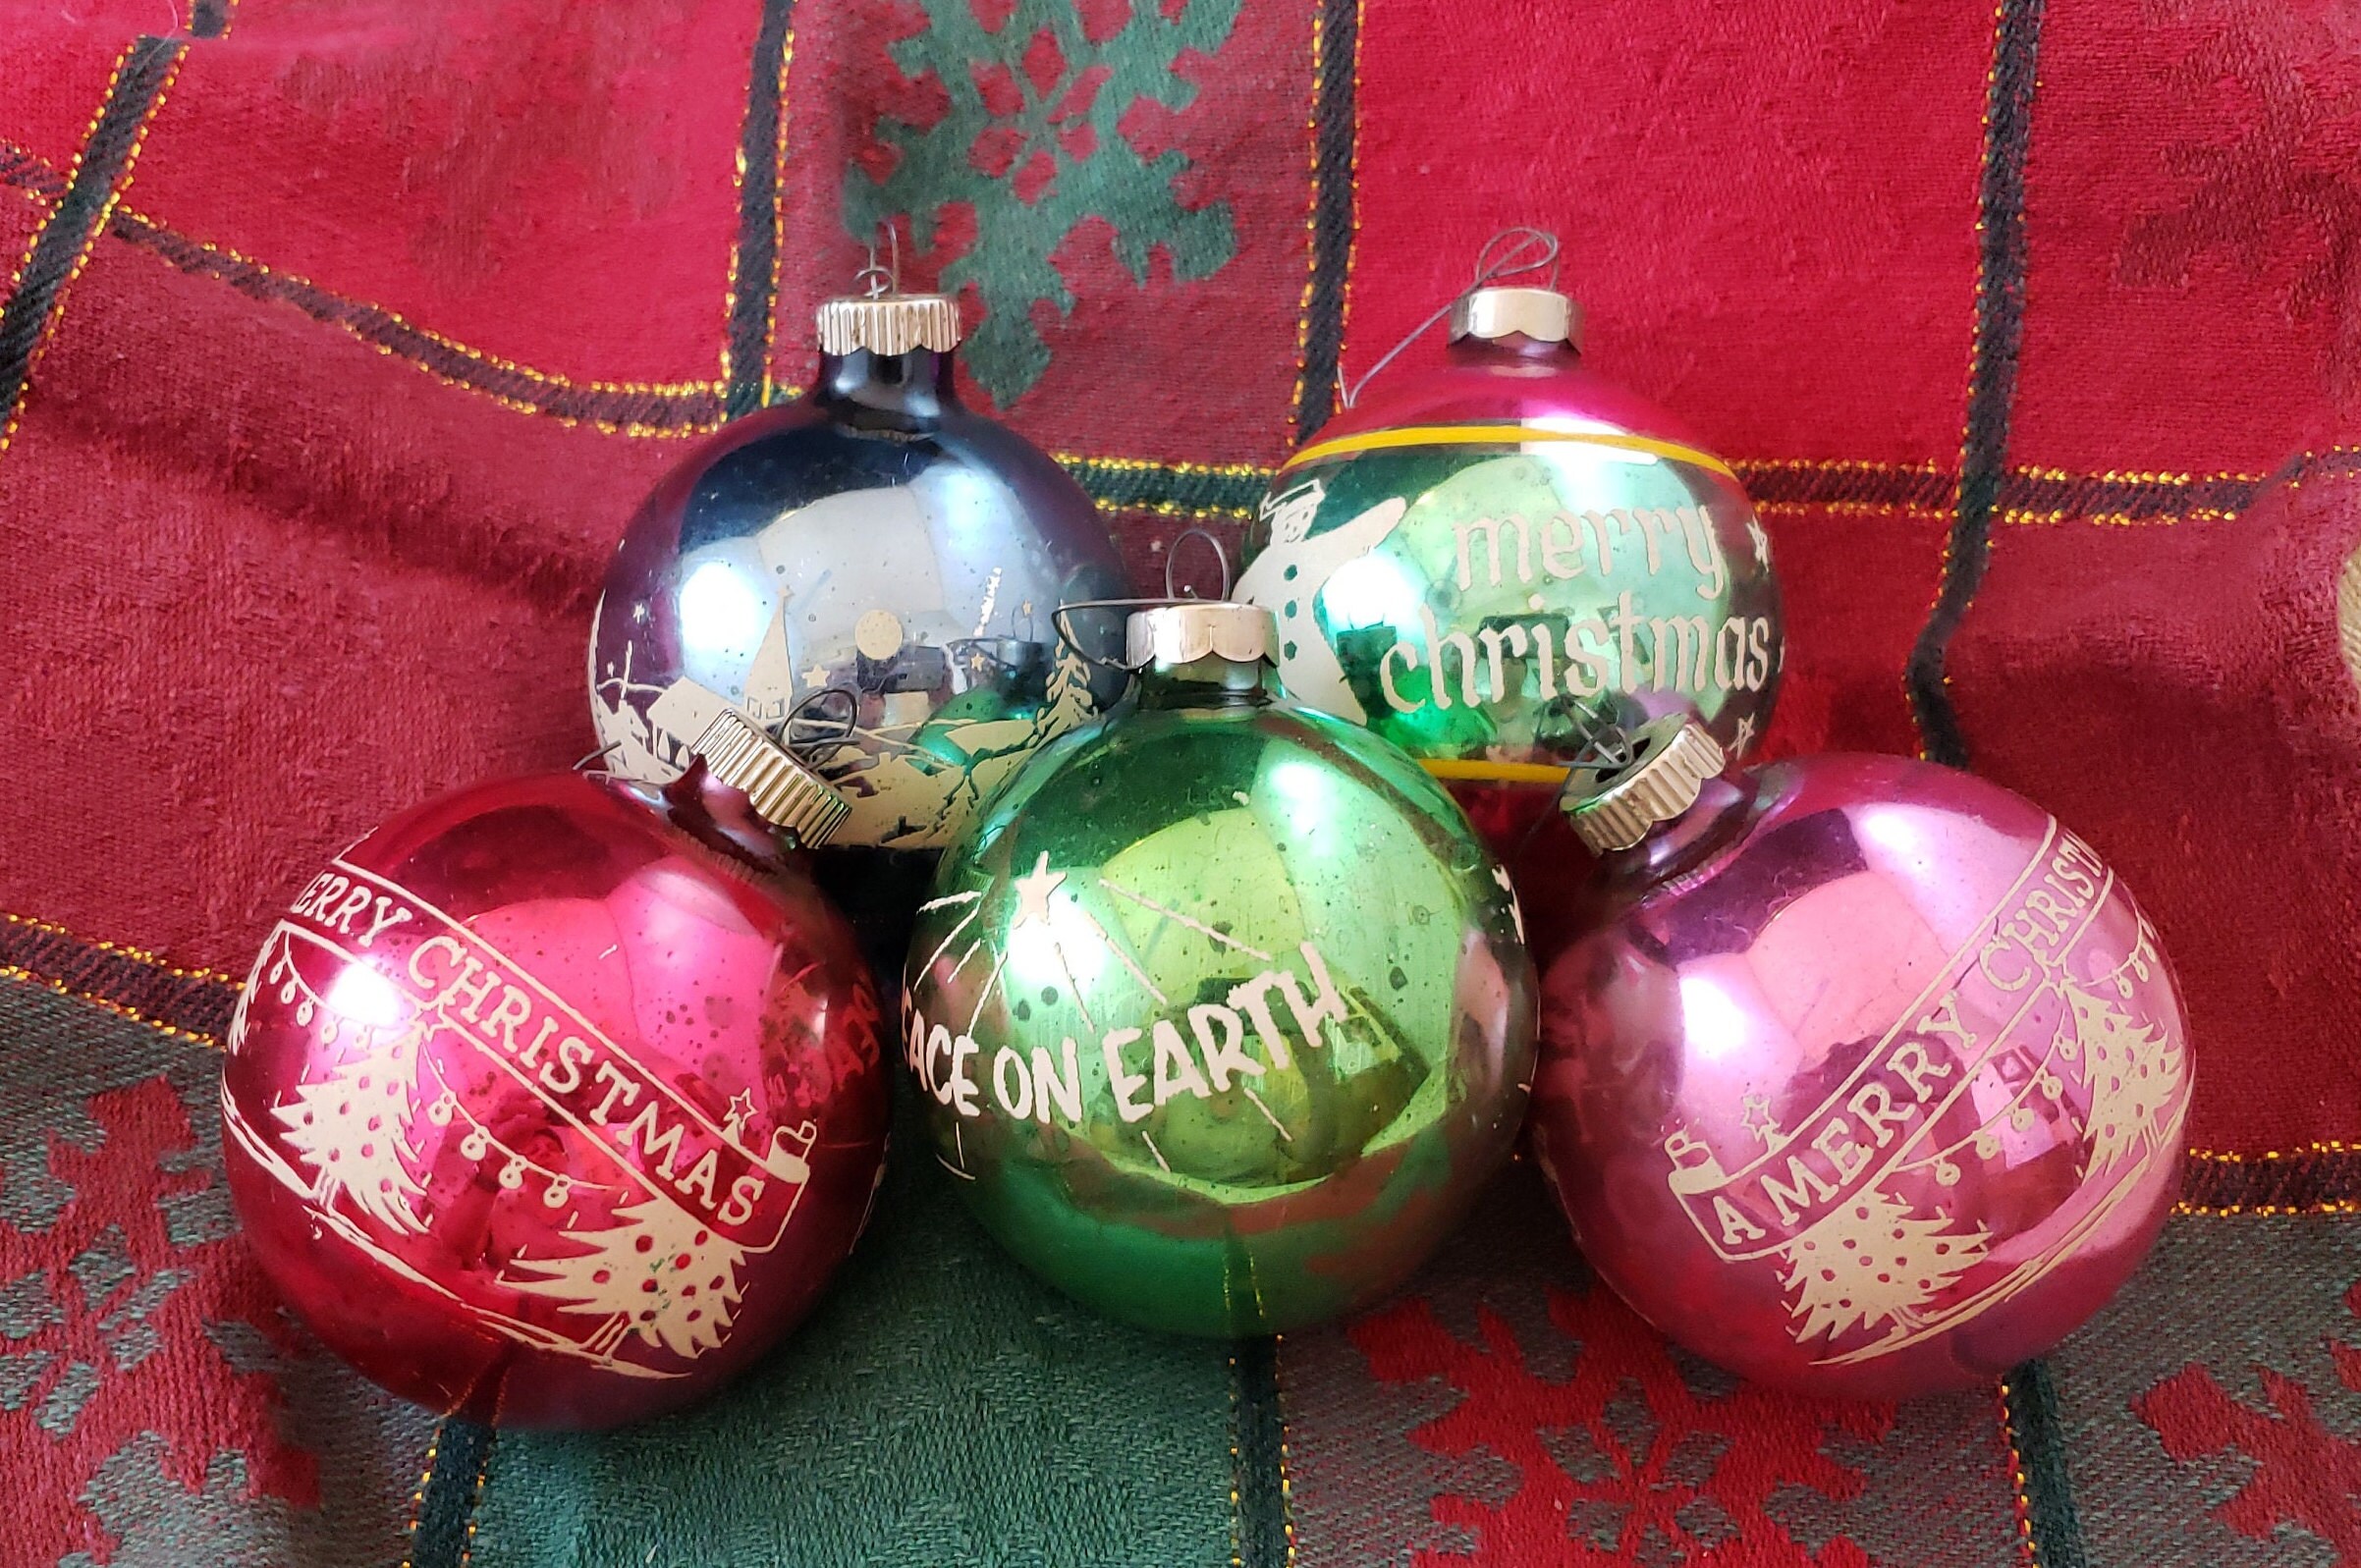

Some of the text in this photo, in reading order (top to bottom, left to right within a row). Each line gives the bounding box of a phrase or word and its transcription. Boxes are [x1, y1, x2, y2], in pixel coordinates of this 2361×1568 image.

[1452, 504, 1728, 600] merry
[1379, 590, 1770, 714] christmas
[289, 870, 413, 947] ERRY
[408, 935, 766, 1227] CHRISTMAS
[901, 985, 980, 1117] ACE
[993, 1037, 1082, 1124] ON
[1101, 941, 1350, 1123] EARTH
[1711, 1196, 1767, 1246] A
[1760, 990, 1978, 1227] MERRY
